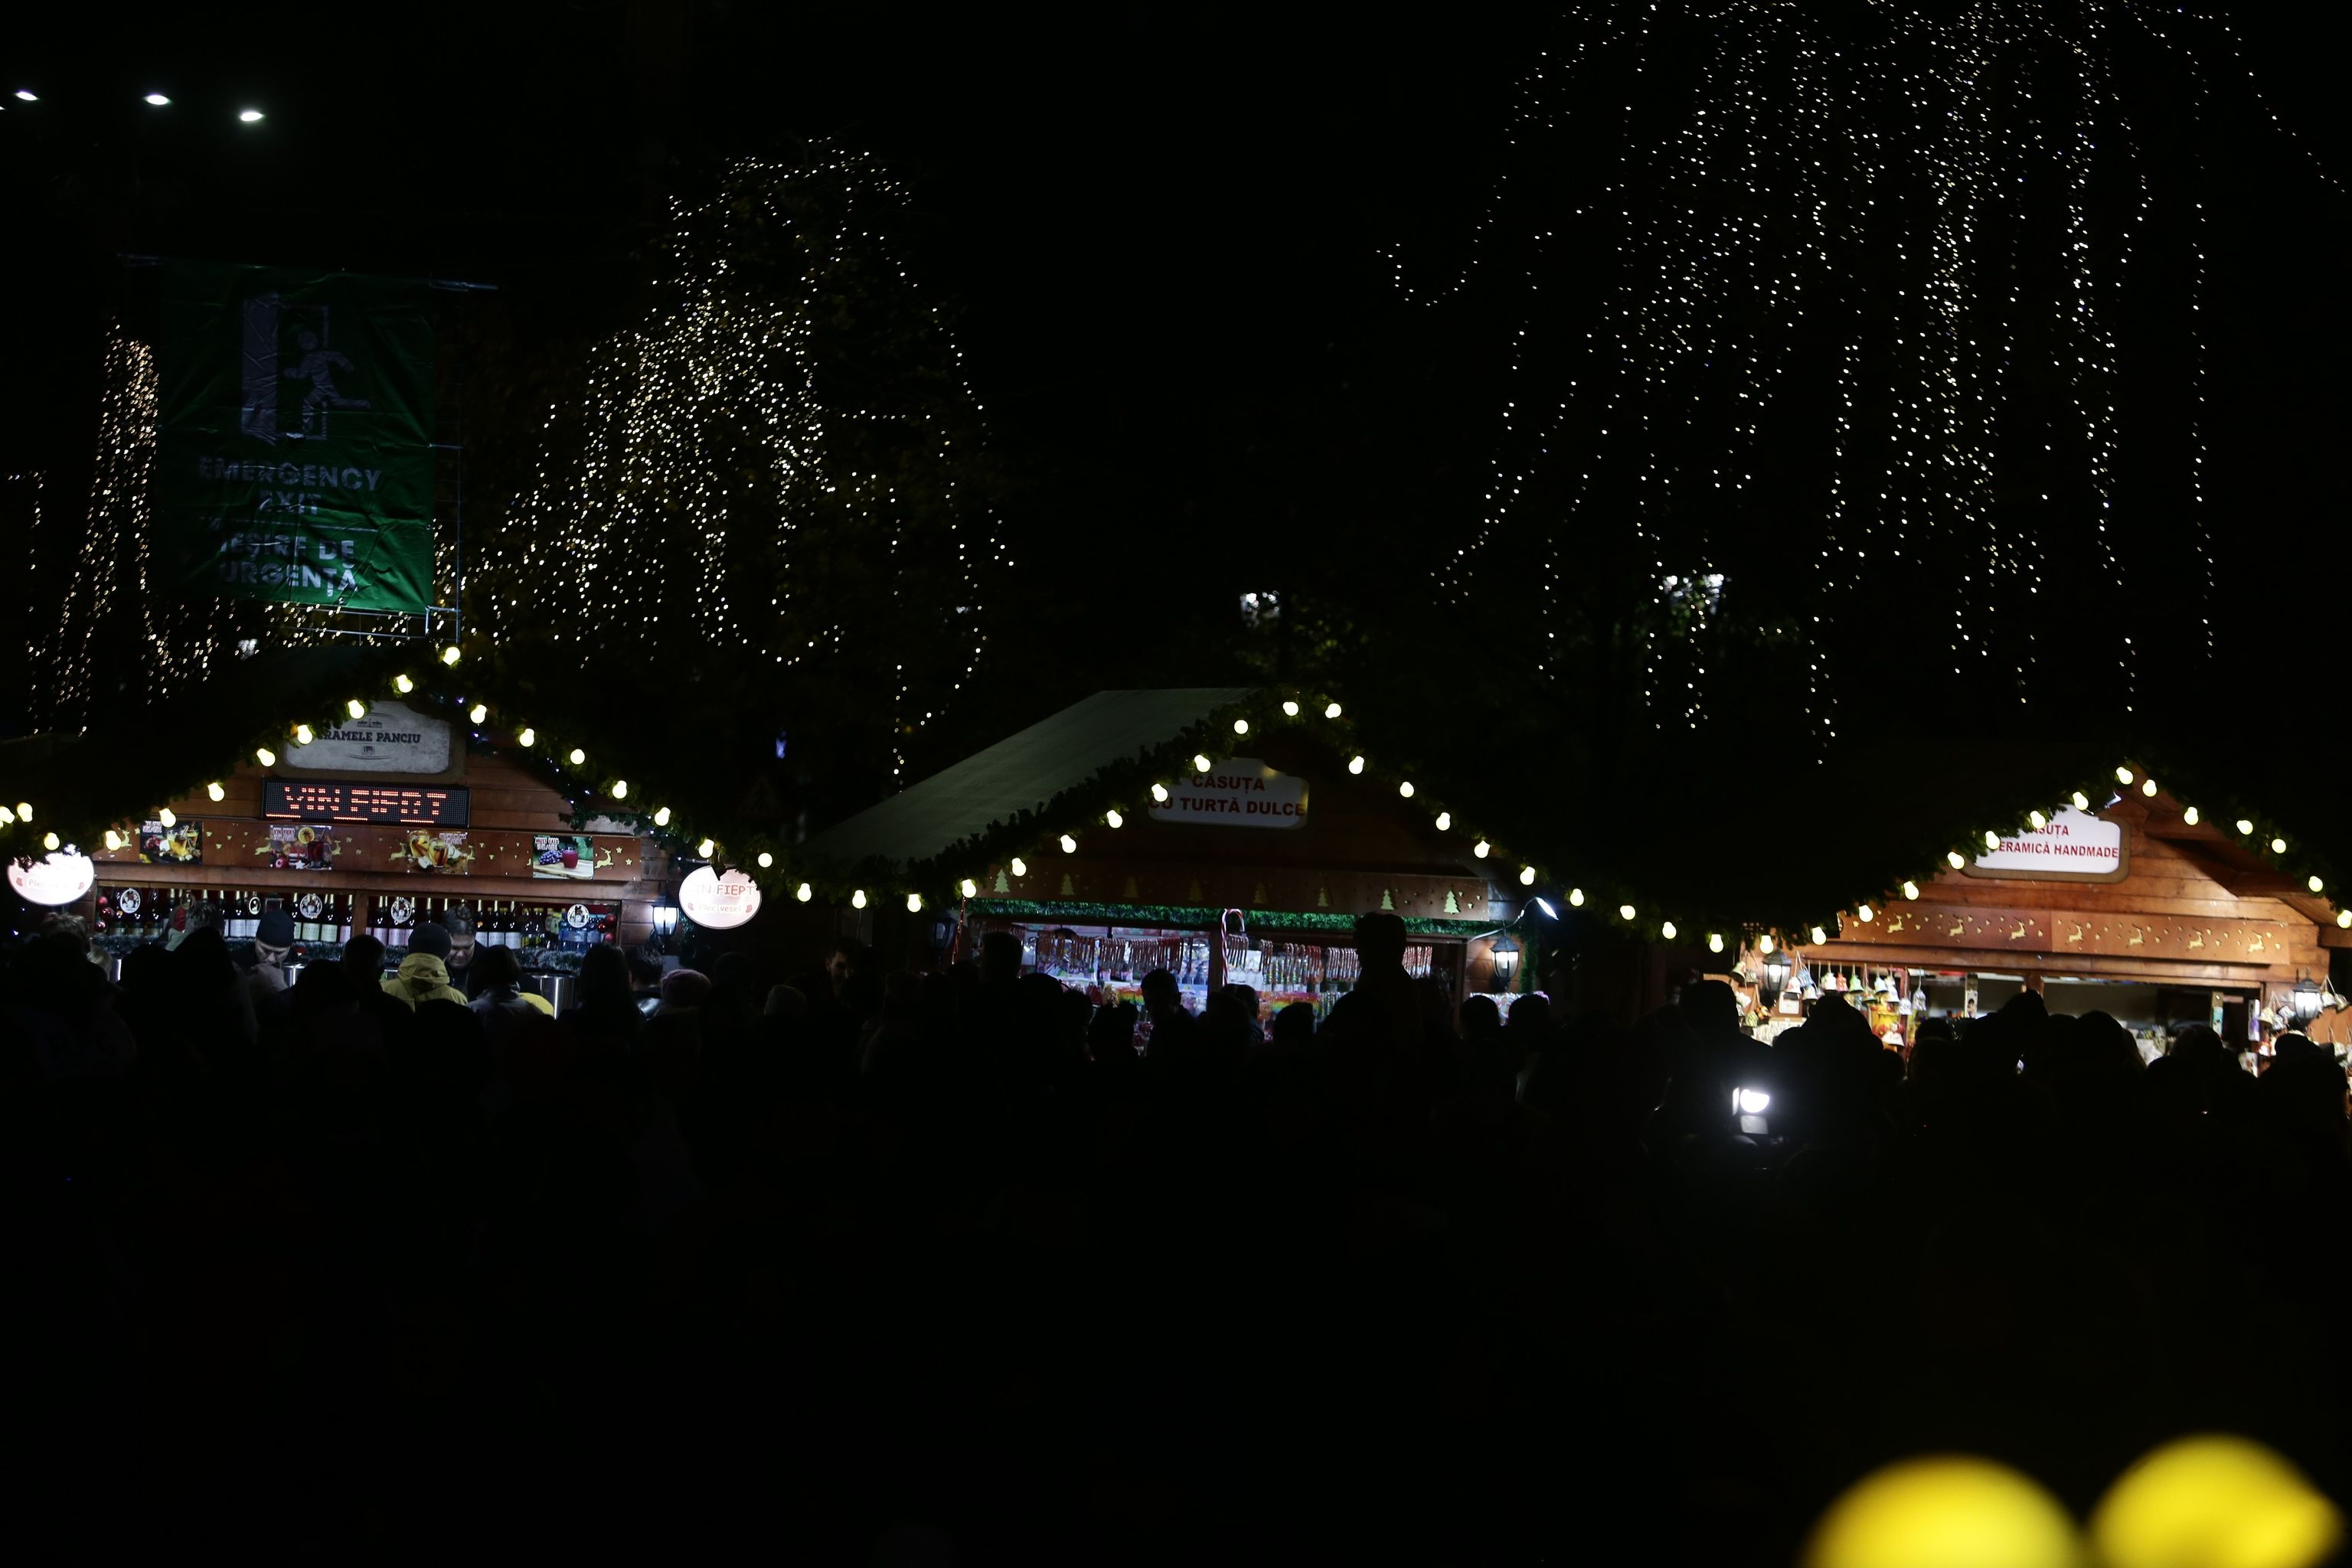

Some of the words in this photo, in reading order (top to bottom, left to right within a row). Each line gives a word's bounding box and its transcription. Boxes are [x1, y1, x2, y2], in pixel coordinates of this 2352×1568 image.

[198, 456, 381, 491] EMERGENCY
[259, 490, 322, 514] EXIT
[318, 537, 355, 560] DE
[317, 729, 373, 742] RAMELE
[376, 732, 422, 744] PANCIU
[283, 785, 341, 812] VIN
[1179, 797, 1240, 814] TURTĂ
[1246, 801, 1306, 817] DULCE
[1998, 841, 2050, 855] ERAMICĂ
[2054, 844, 2118, 858] HANDMADE
